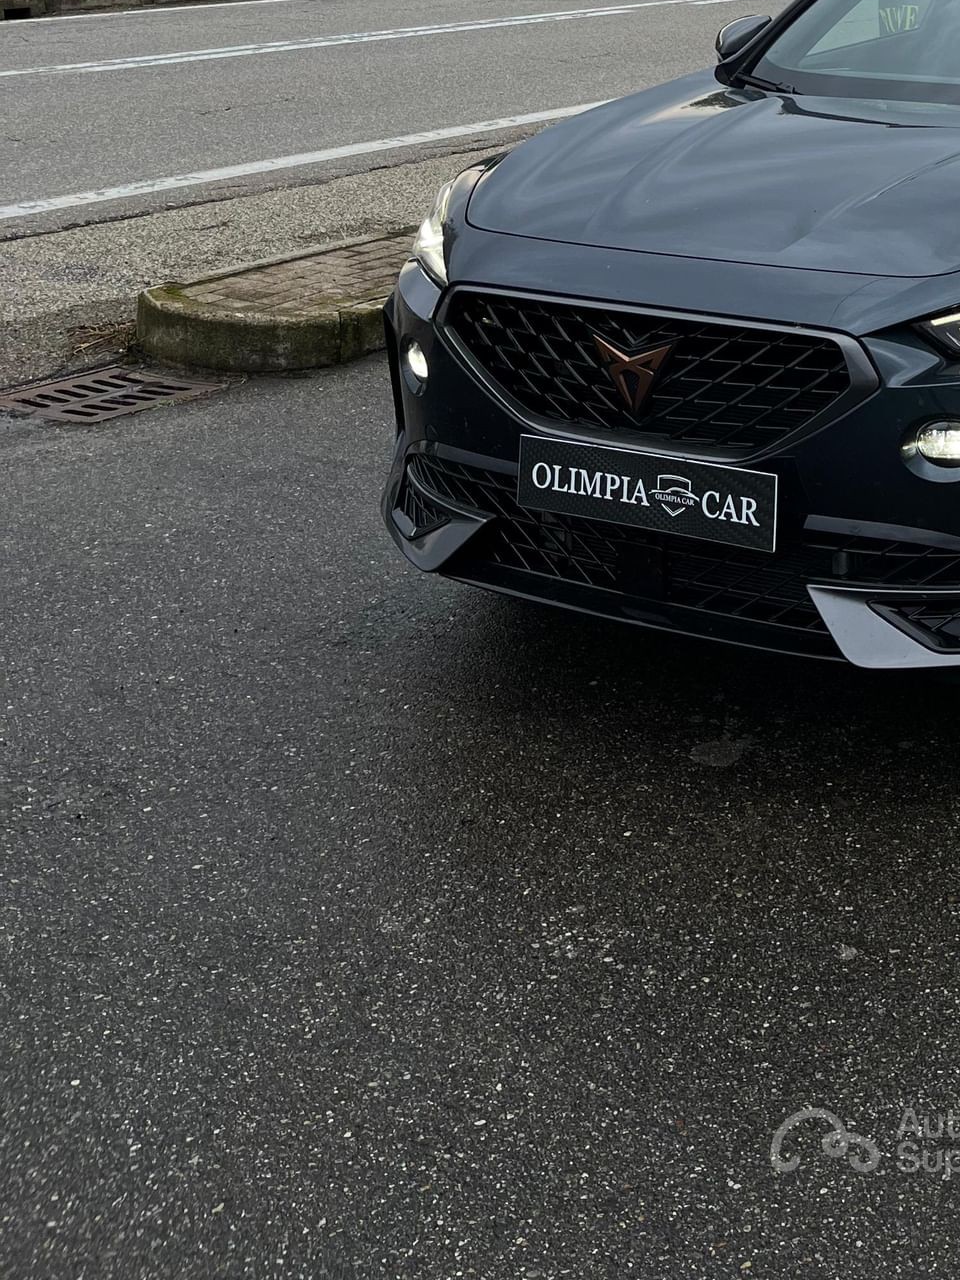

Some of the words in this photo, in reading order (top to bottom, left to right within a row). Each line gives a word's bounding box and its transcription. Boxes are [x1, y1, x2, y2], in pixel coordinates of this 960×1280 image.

[531, 462, 650, 507] OLIMPIA
[701, 490, 761, 527] CAR
[654, 493, 681, 504] OLIMPIA
[681, 497, 695, 506] CAR
